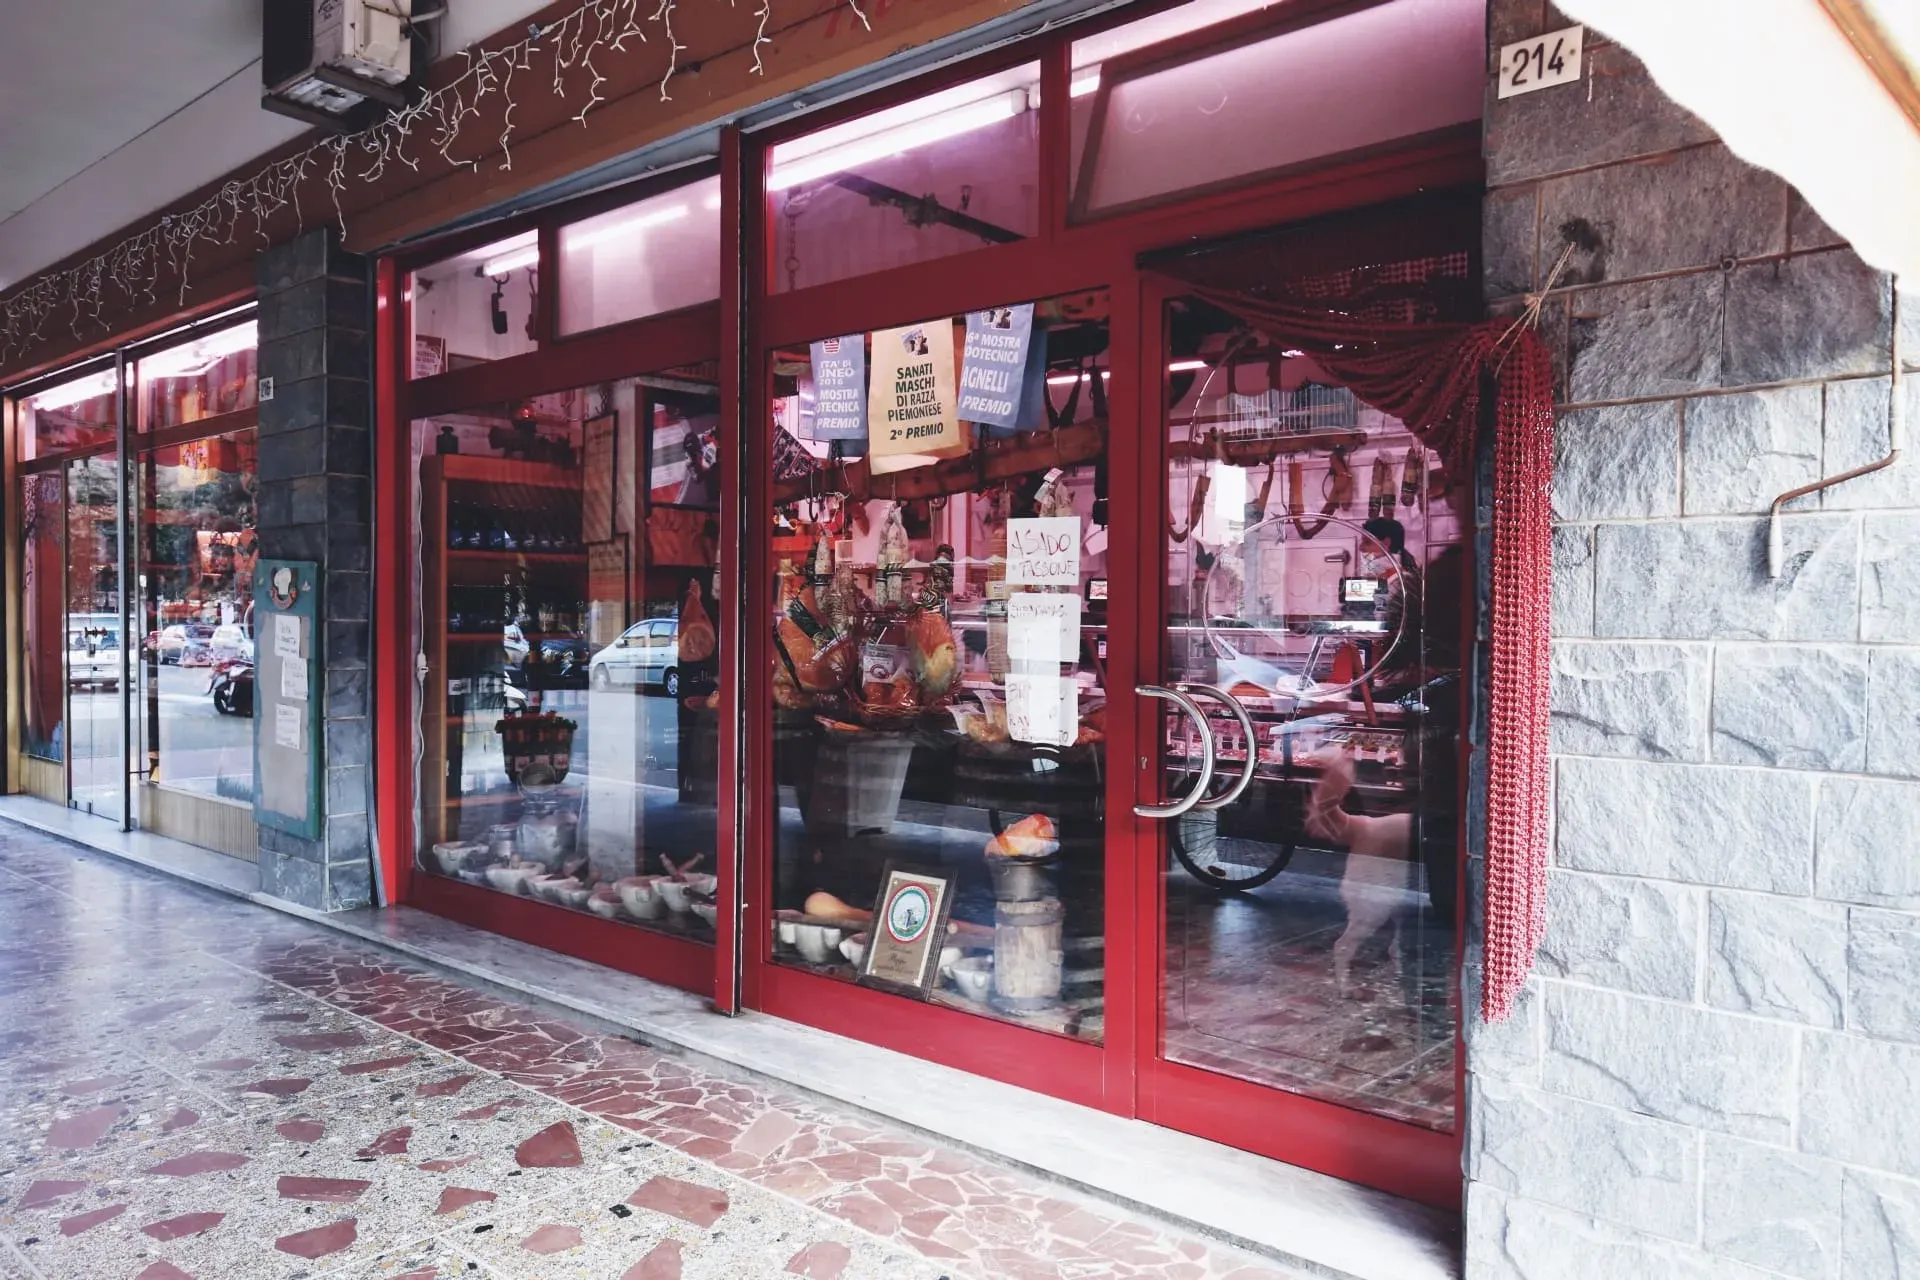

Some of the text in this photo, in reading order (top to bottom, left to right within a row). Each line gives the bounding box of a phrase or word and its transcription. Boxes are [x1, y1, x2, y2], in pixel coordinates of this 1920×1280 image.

[1511, 37, 1565, 86] 214
[981, 334, 1021, 349] MOSTRA
[896, 362, 933, 380] SANATI
[895, 376, 935, 393] MASCHI
[820, 388, 859, 400] MOSTRA
[896, 390, 936, 407] DI RAZZA
[887, 402, 942, 422] PIEMONTESE
[961, 395, 1012, 416] PREMIO
[816, 416, 860, 429] PREMIO
[906, 422, 944, 439] PREMIO
